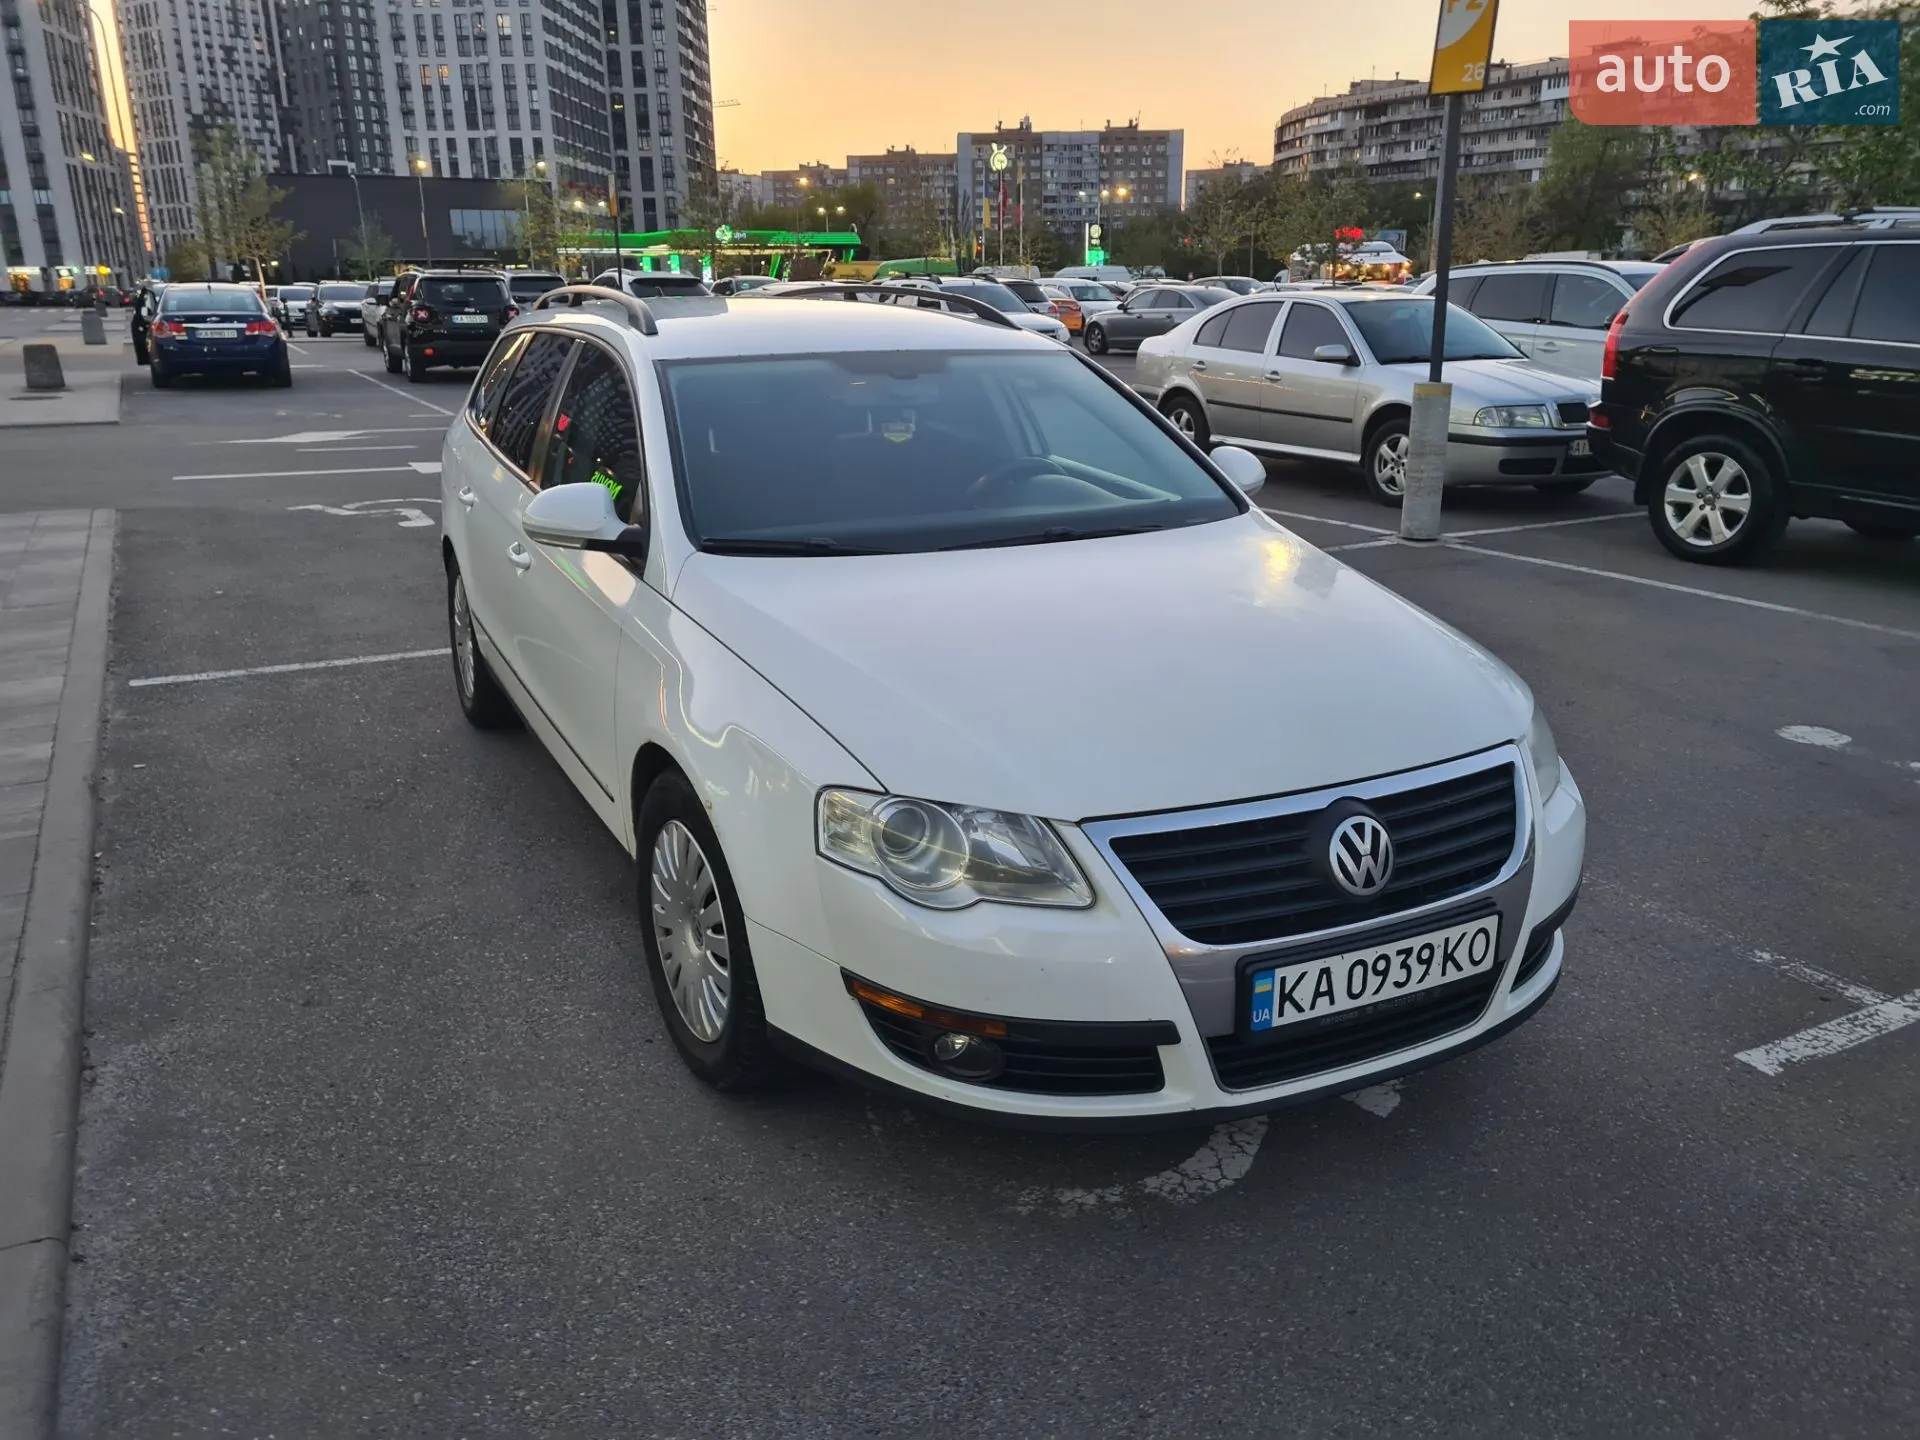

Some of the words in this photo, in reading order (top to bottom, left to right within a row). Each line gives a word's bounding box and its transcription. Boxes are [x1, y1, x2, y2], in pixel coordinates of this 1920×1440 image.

[1462, 62, 1485, 82] 26
[1277, 966, 1336, 1018] KA
[1346, 942, 1436, 1000] 0939
[1252, 1008, 1271, 1023] UA
